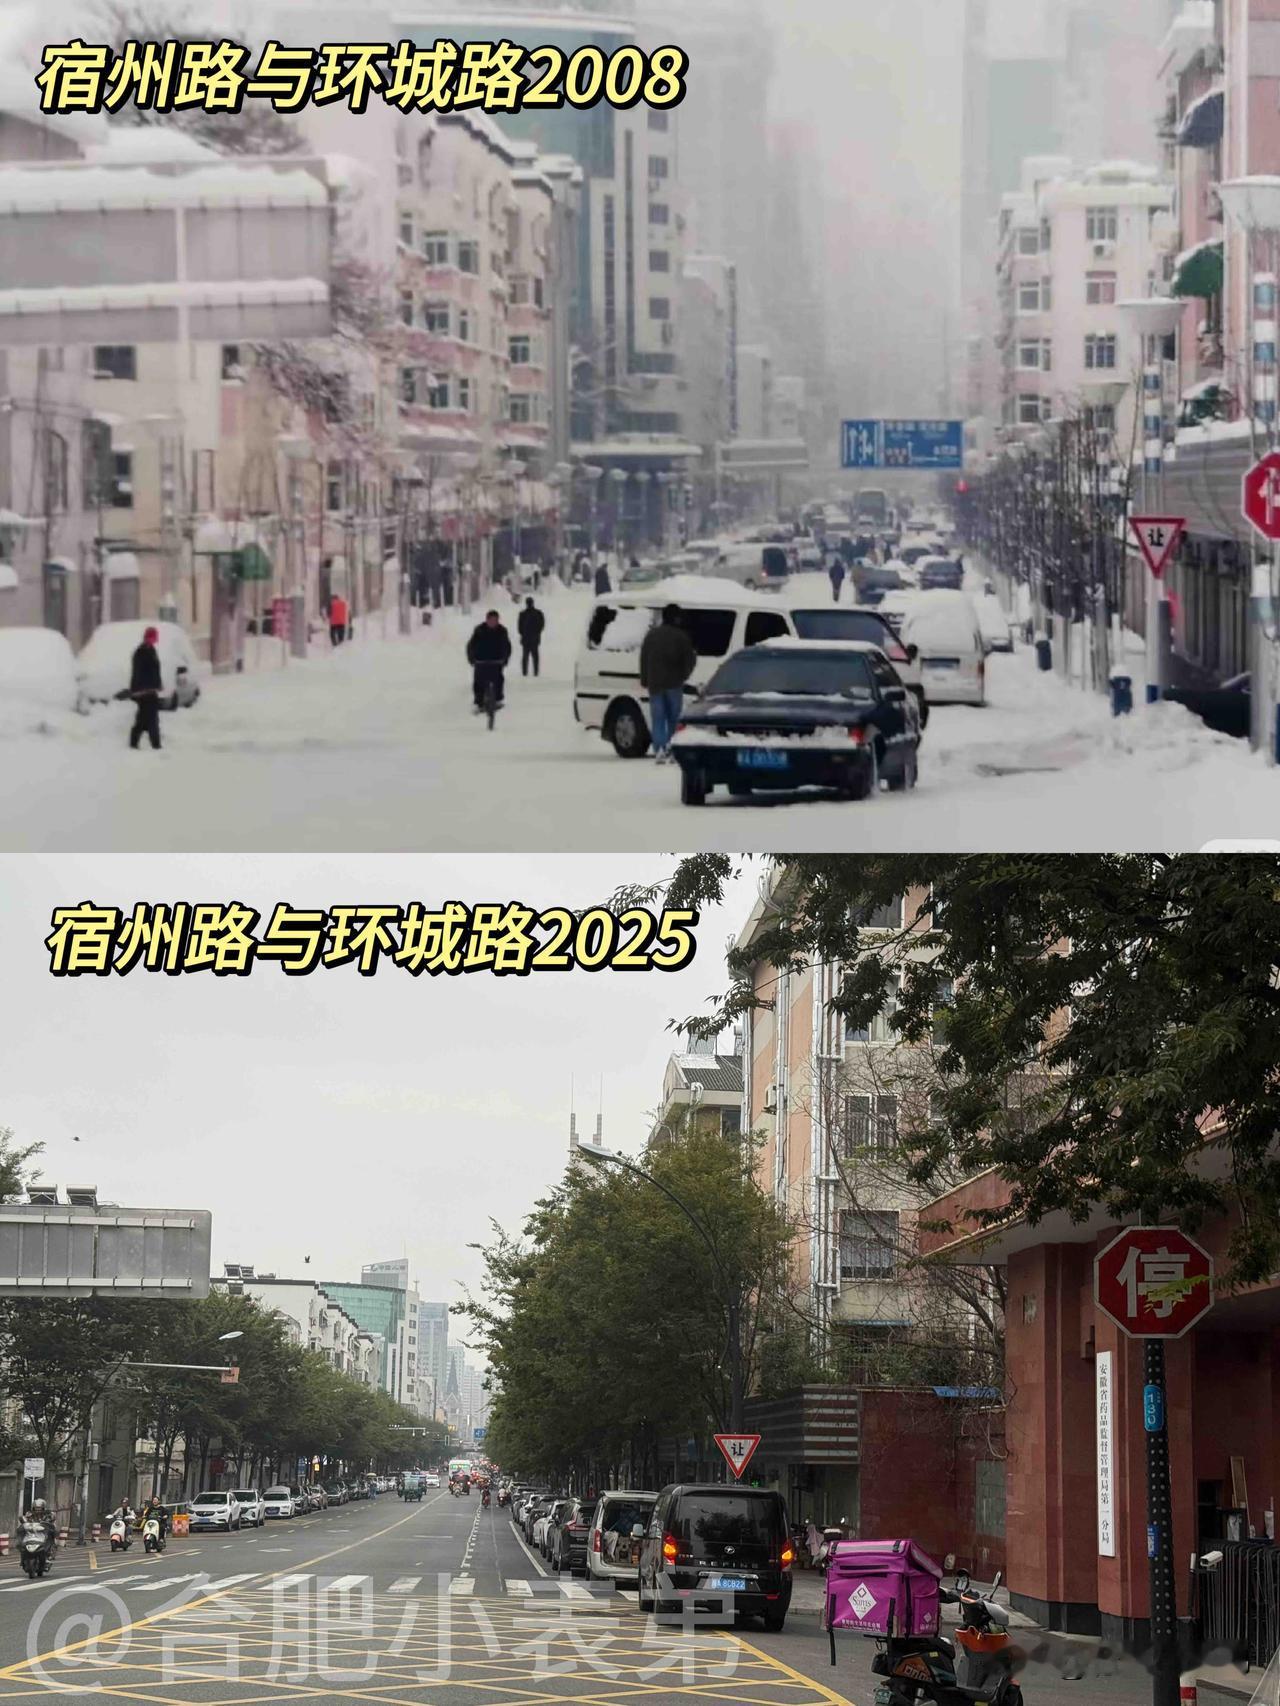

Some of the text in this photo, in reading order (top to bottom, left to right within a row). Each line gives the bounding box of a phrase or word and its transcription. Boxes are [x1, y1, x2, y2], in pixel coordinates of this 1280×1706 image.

[1148, 527, 1164, 547] 让
[1115, 1246, 1192, 1318] 停
[1147, 1392, 1156, 1425] 130
[731, 1442, 744, 1456] 让
[1099, 1363, 1110, 1544] 安徽省药品监督管理局第一分局
[699, 1560, 759, 1569] REFINE
